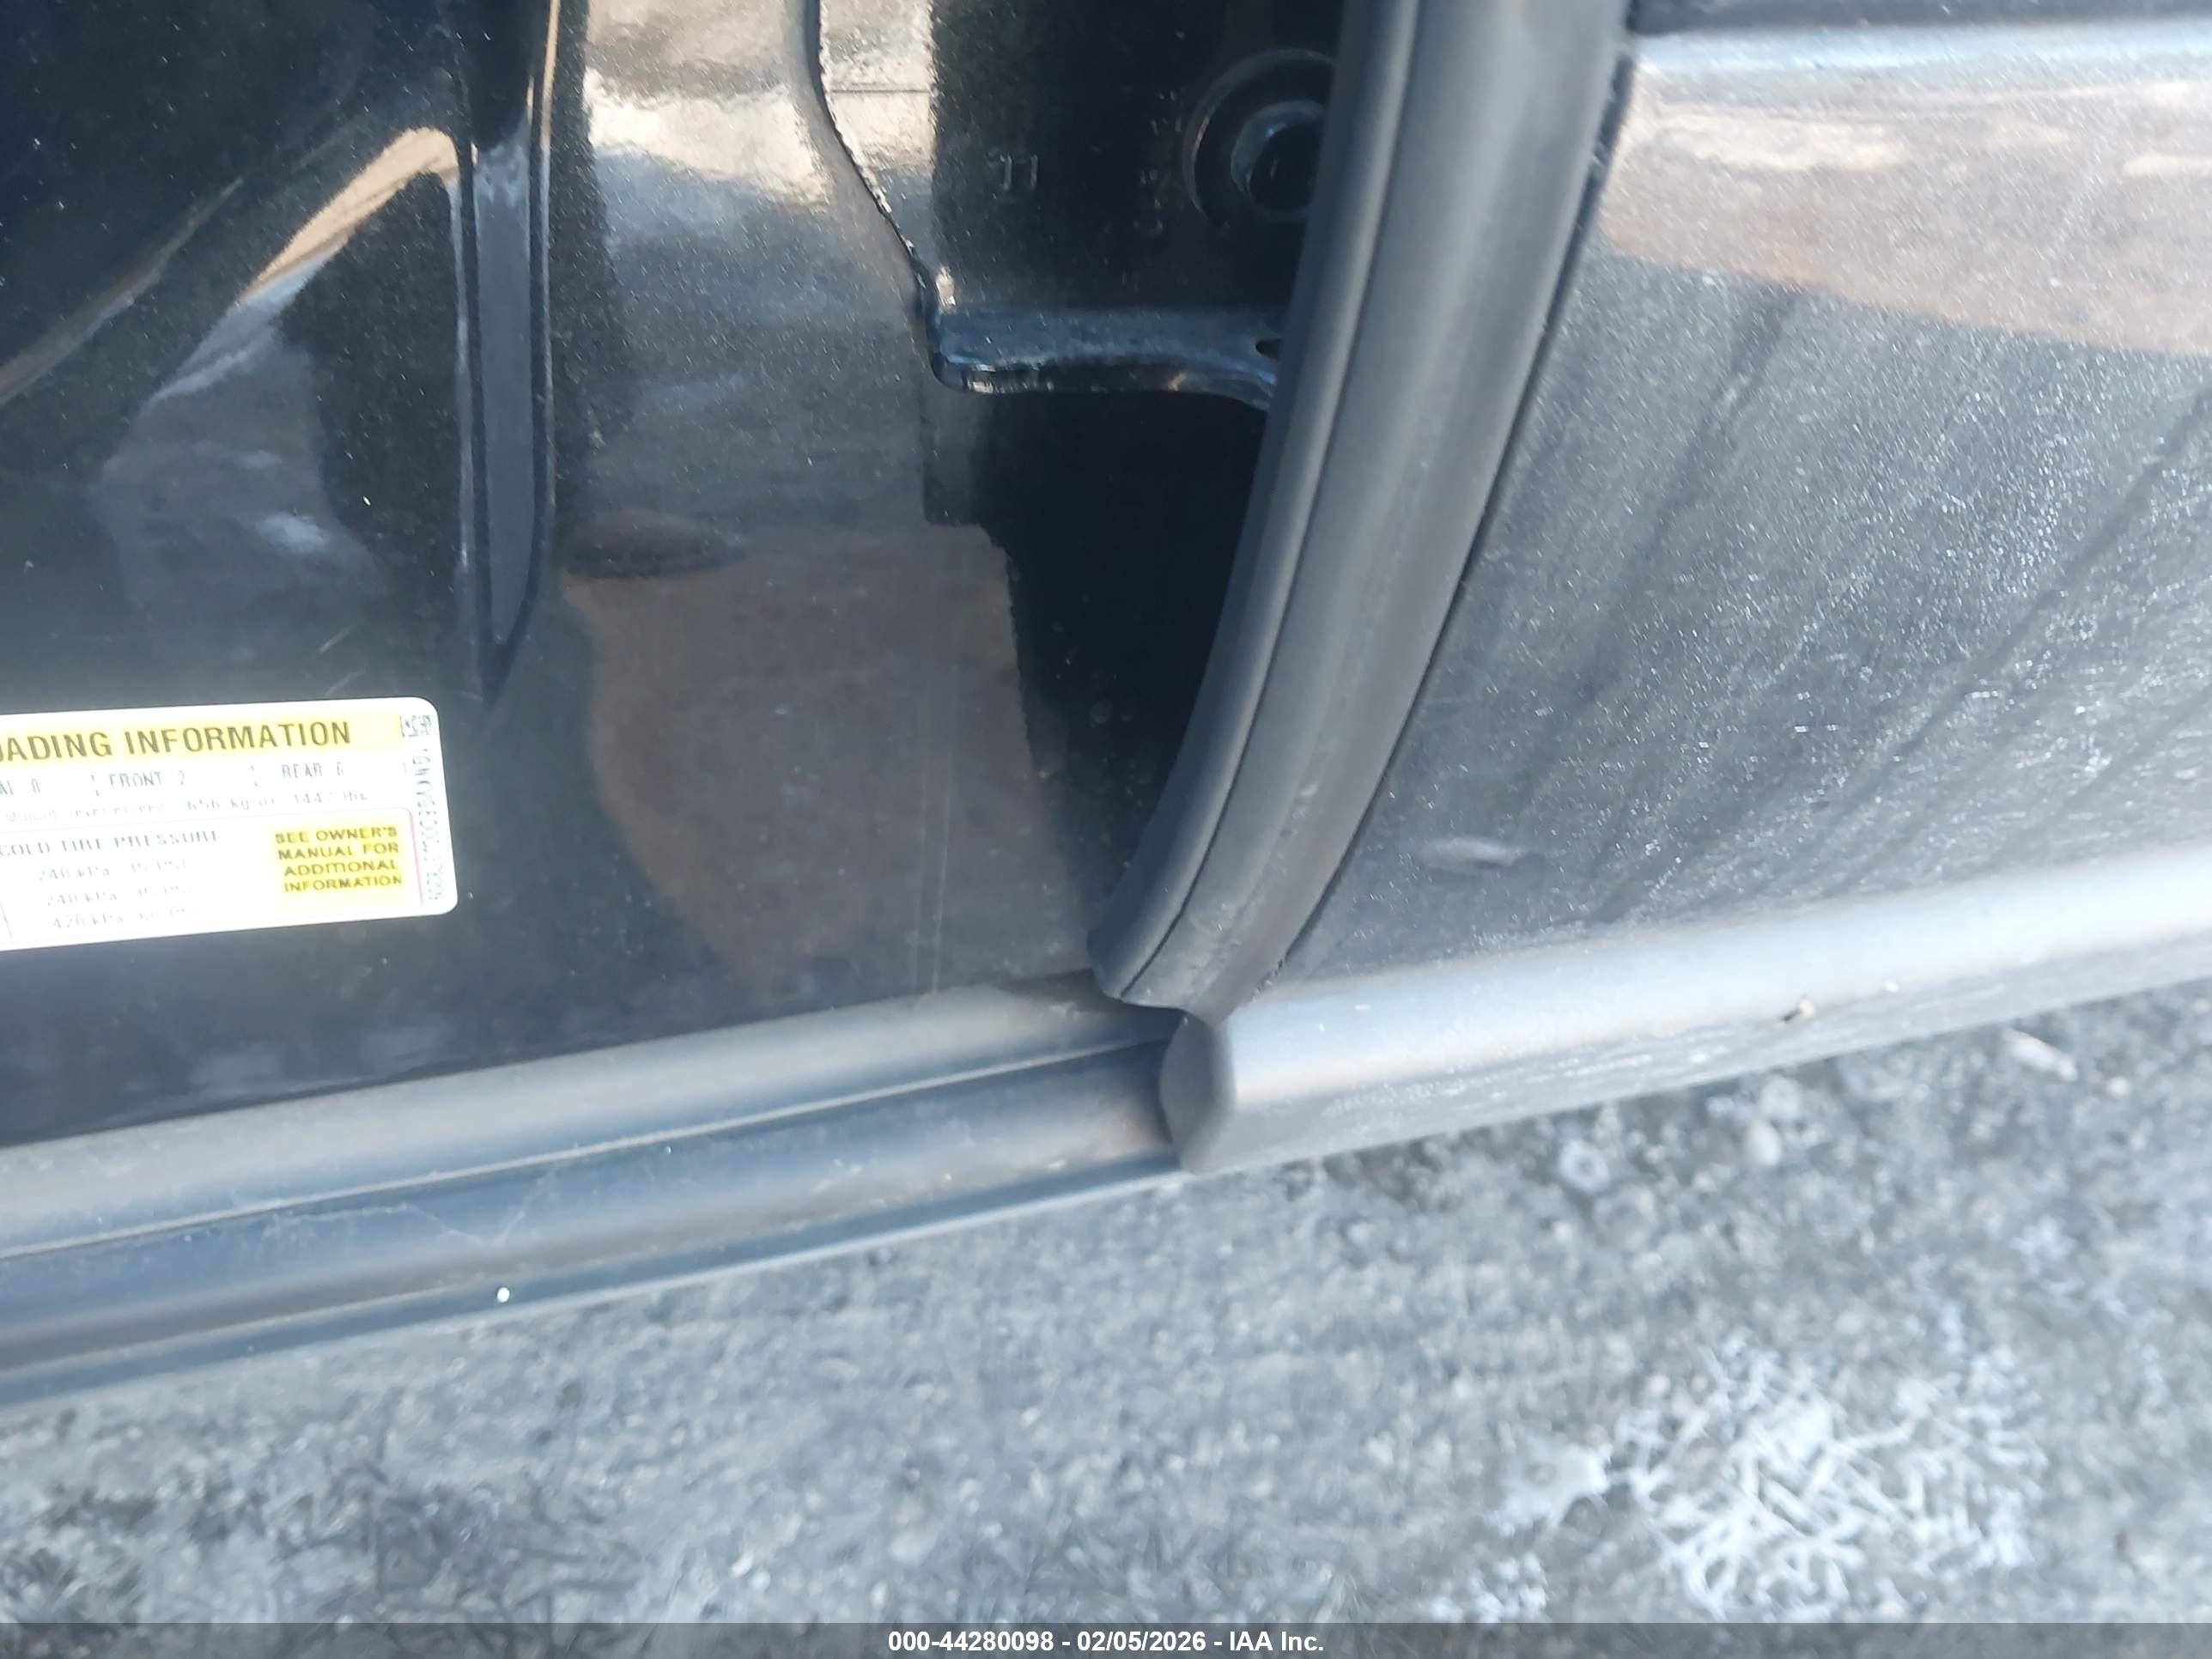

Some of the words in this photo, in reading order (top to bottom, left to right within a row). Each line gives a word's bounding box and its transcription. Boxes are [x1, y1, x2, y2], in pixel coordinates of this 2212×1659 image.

[0, 732, 112, 763] ADING
[125, 721, 350, 755] INFORMATION
[108, 771, 162, 788] FRONT
[281, 763, 323, 779] REAR
[275, 832, 309, 844] SEE
[315, 826, 398, 842] OWNER'S
[278, 845, 355, 860] MANUAL
[362, 842, 399, 855] FOR
[284, 860, 398, 876] ADDITIONAL
[284, 875, 402, 892] INFORMATION
